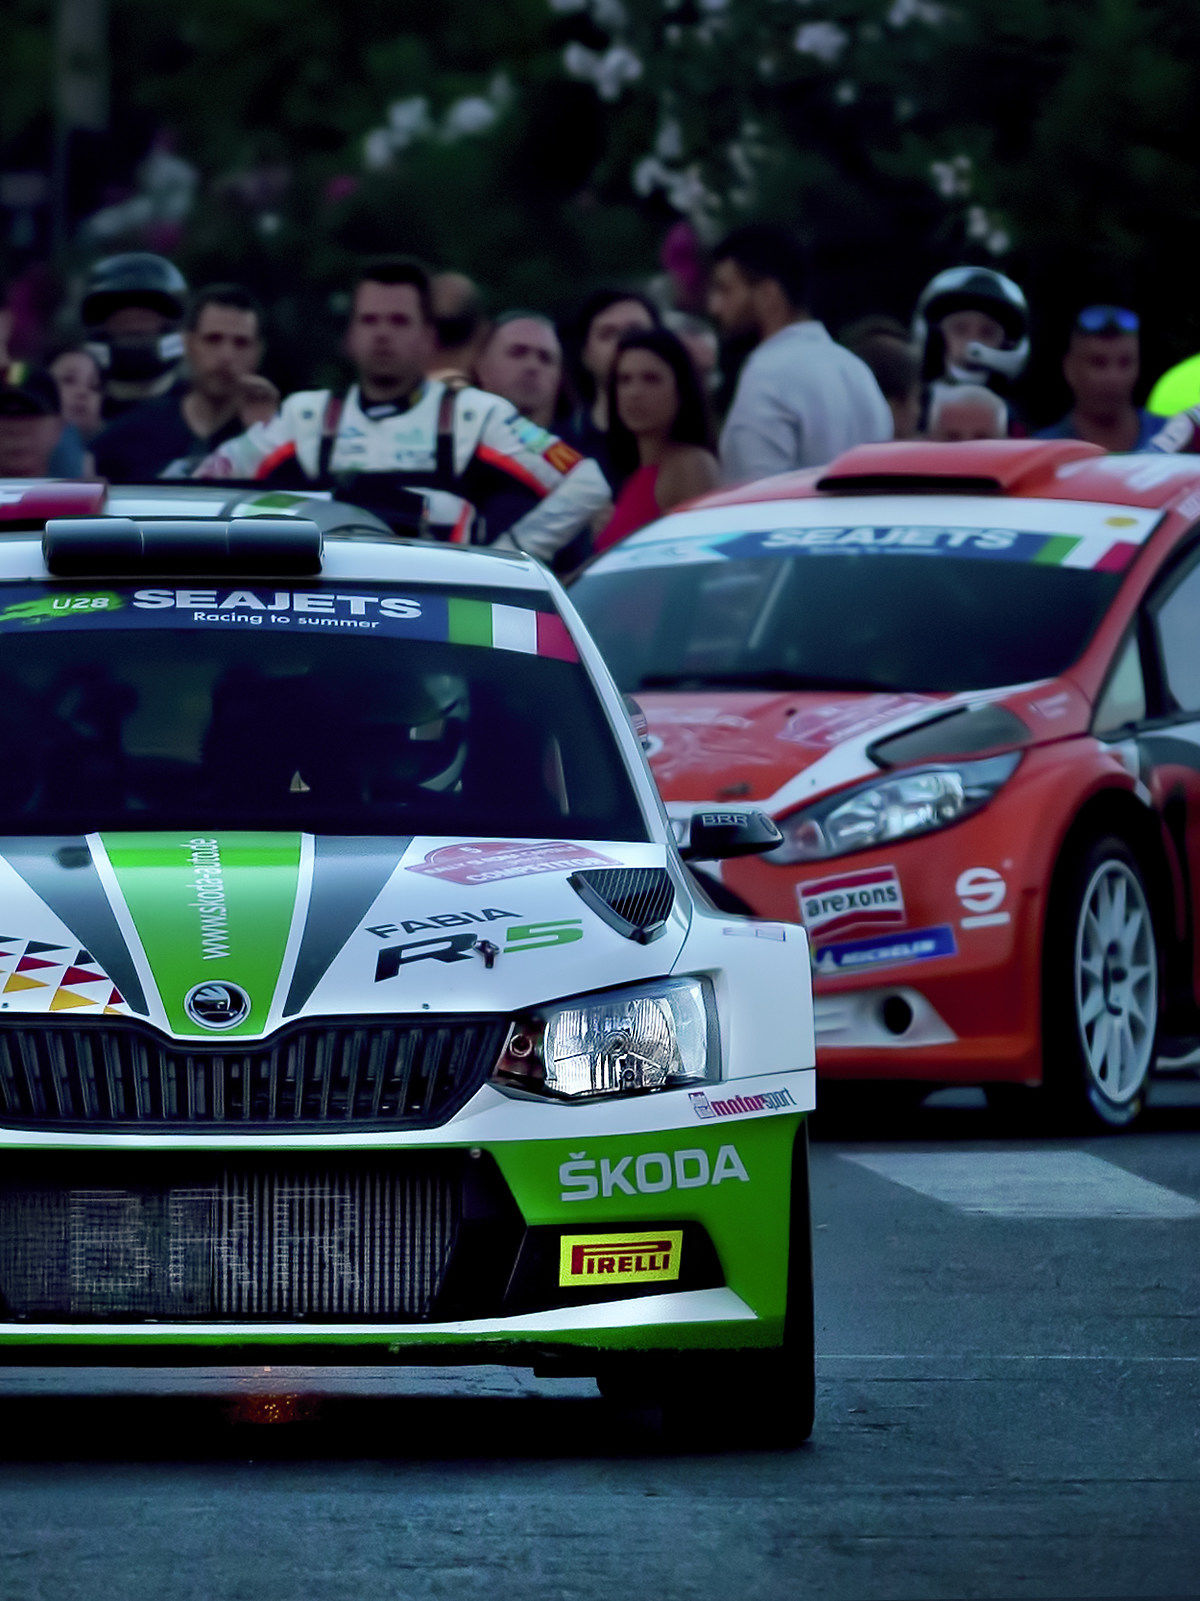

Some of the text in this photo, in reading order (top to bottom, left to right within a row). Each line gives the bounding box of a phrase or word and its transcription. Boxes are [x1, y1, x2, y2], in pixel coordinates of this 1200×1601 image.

[761, 527, 1018, 550] SEAJETS
[53, 597, 110, 609] U28
[133, 589, 422, 619] SEAJETS
[193, 611, 380, 629] Racing to summer
[805, 885, 898, 918] arexons
[364, 908, 524, 939] FABIA
[374, 918, 584, 983] R5
[711, 1087, 798, 1117] motorsport
[559, 1144, 750, 1202] ŠKODA
[571, 1240, 673, 1275] PIRELLI
